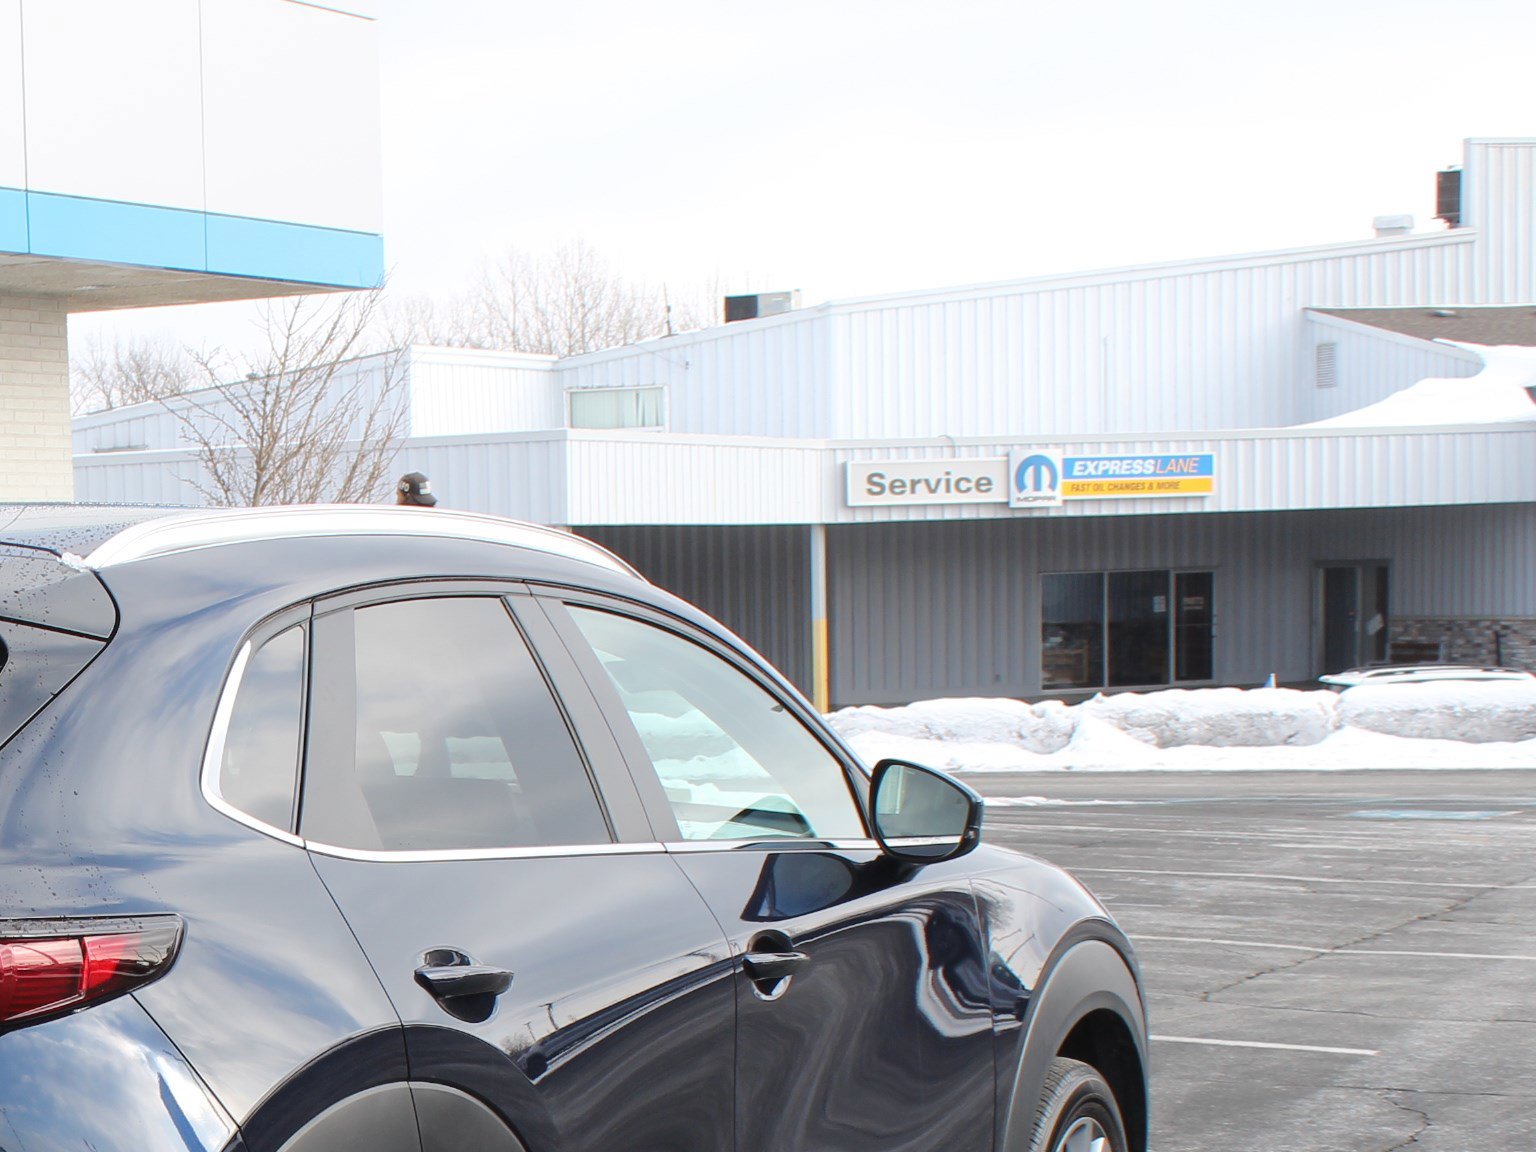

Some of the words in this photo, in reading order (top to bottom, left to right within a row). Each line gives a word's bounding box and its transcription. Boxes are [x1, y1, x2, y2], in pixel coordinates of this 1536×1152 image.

[865, 471, 994, 496] Service
[1071, 483, 1090, 492] FAST
[1092, 483, 1105, 492] OIL
[1107, 481, 1146, 491] CHANGES
[1155, 480, 1181, 490] MORE
